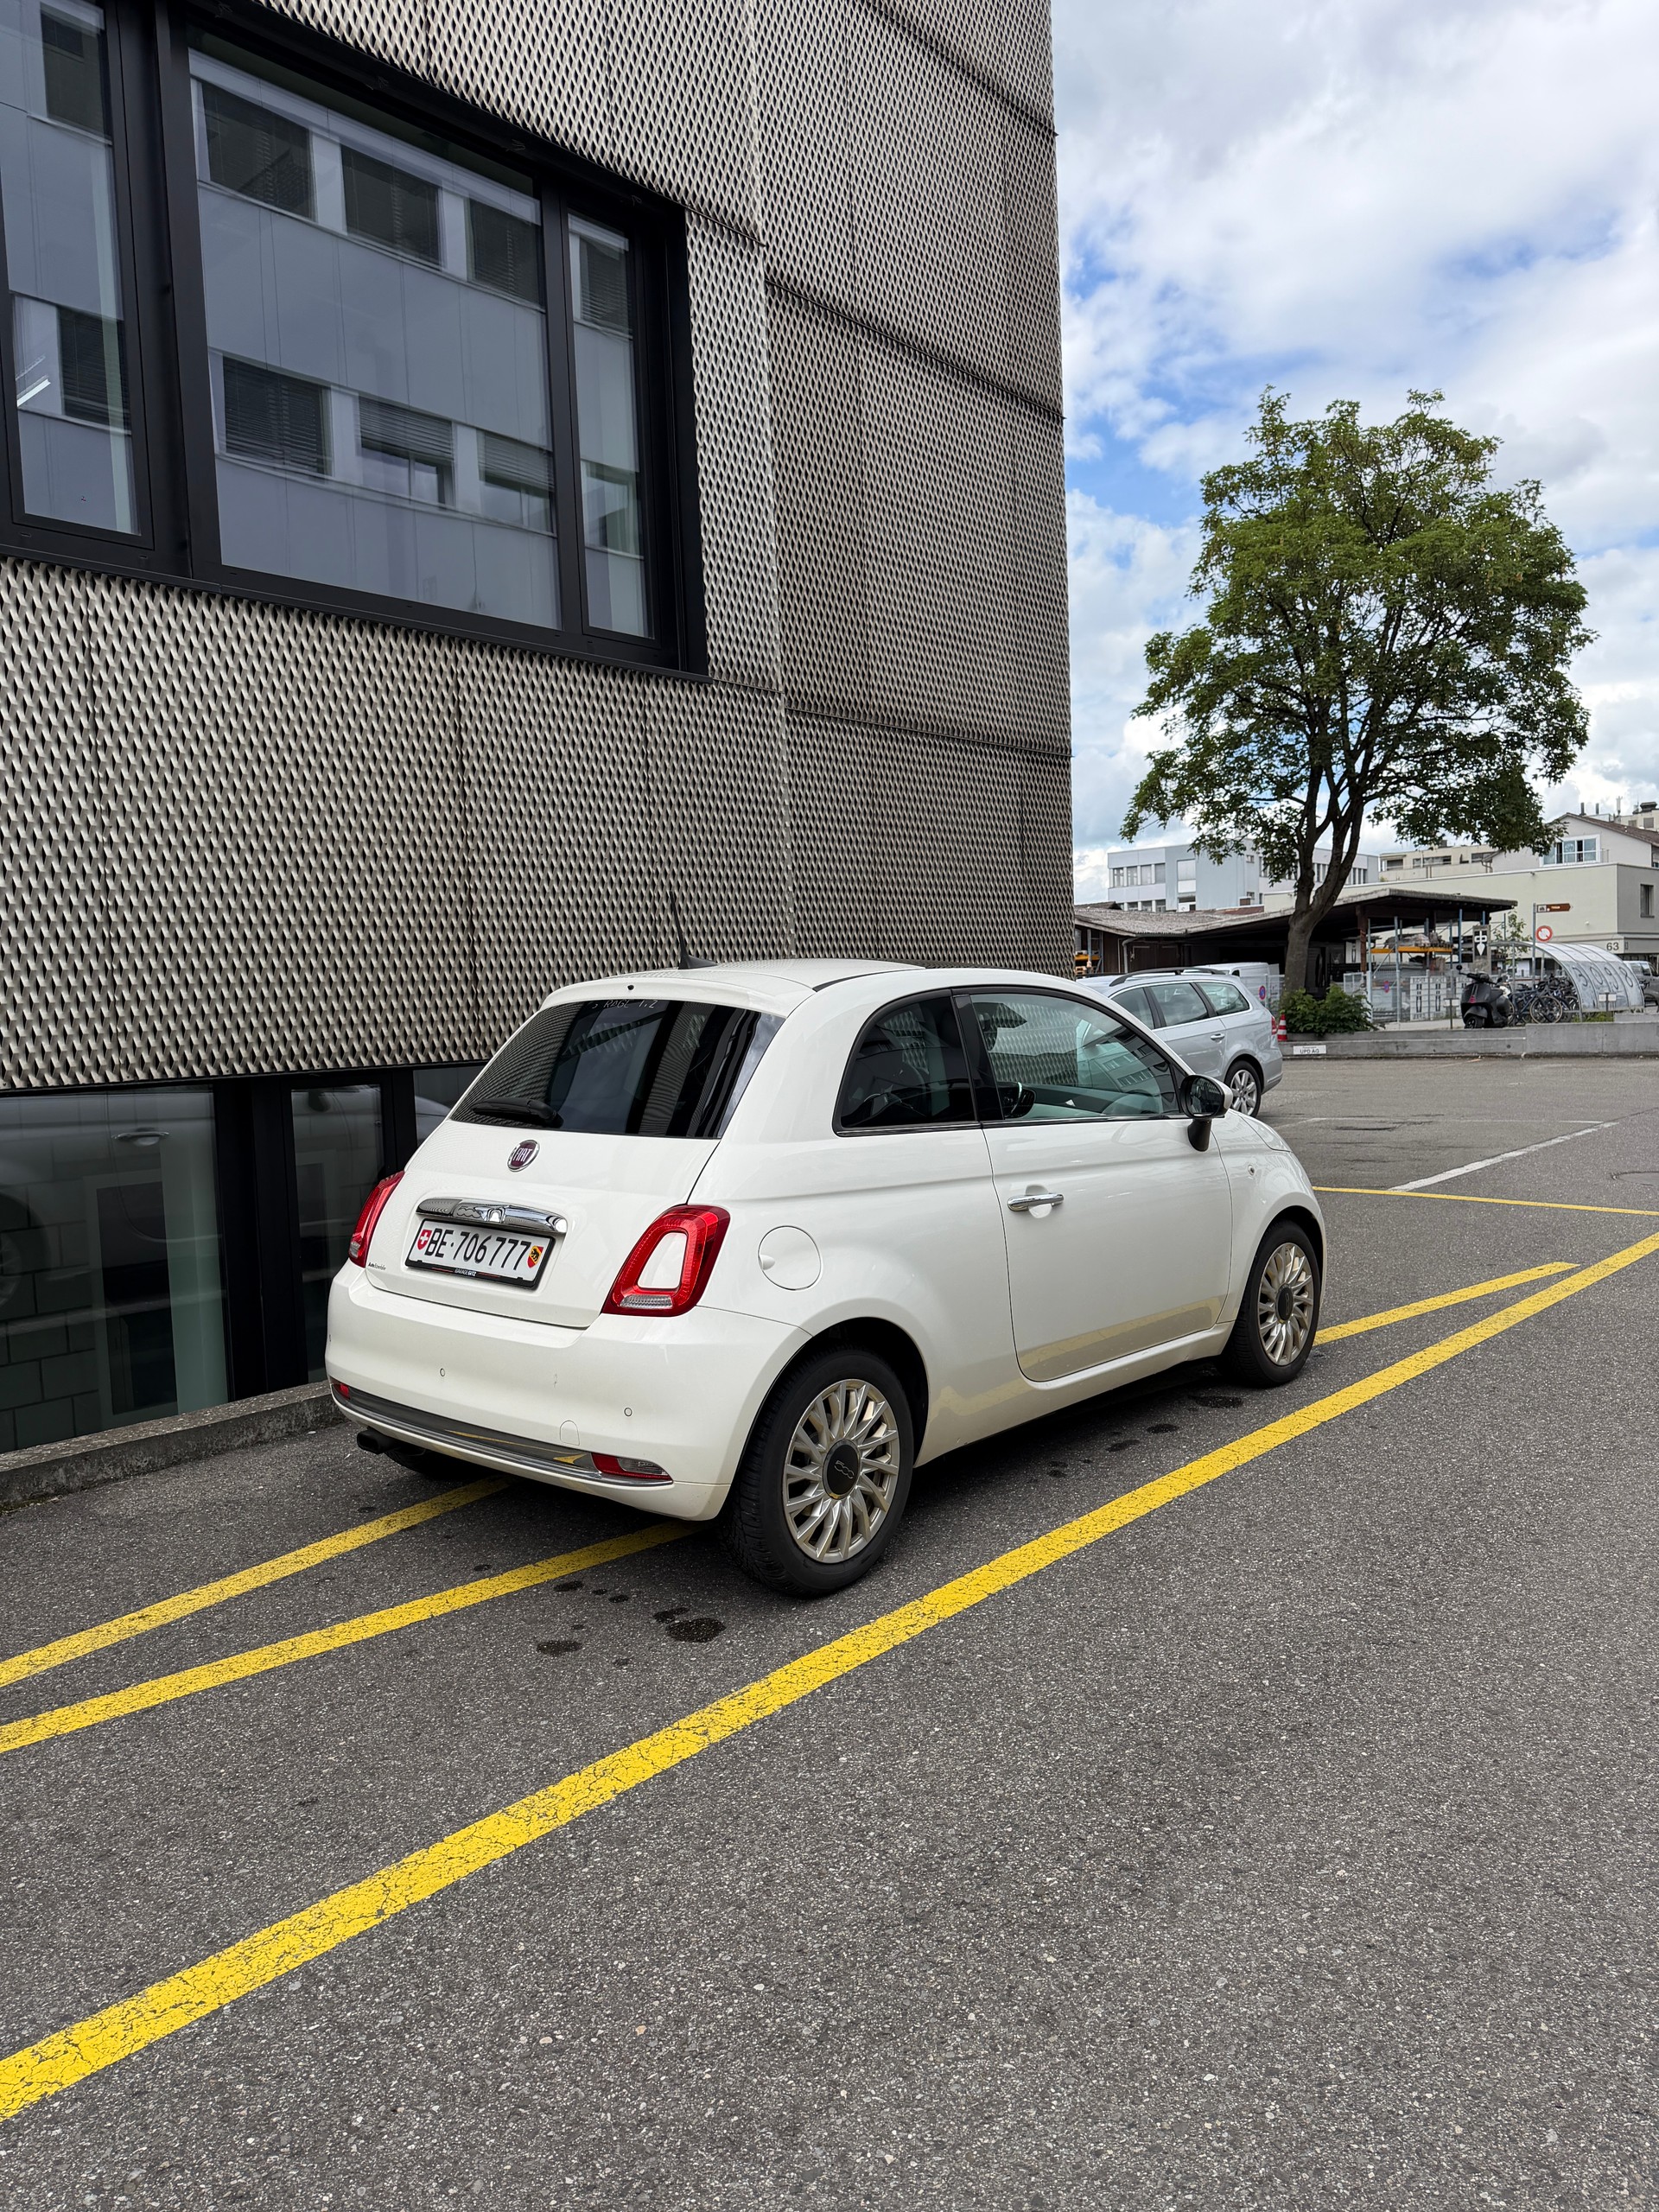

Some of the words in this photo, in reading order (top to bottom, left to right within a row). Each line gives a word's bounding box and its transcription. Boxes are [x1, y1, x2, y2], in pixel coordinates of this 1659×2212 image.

[1606, 942, 1619, 950] 63
[512, 1147, 533, 1162] FIAT
[834, 1459, 855, 1479] 500
